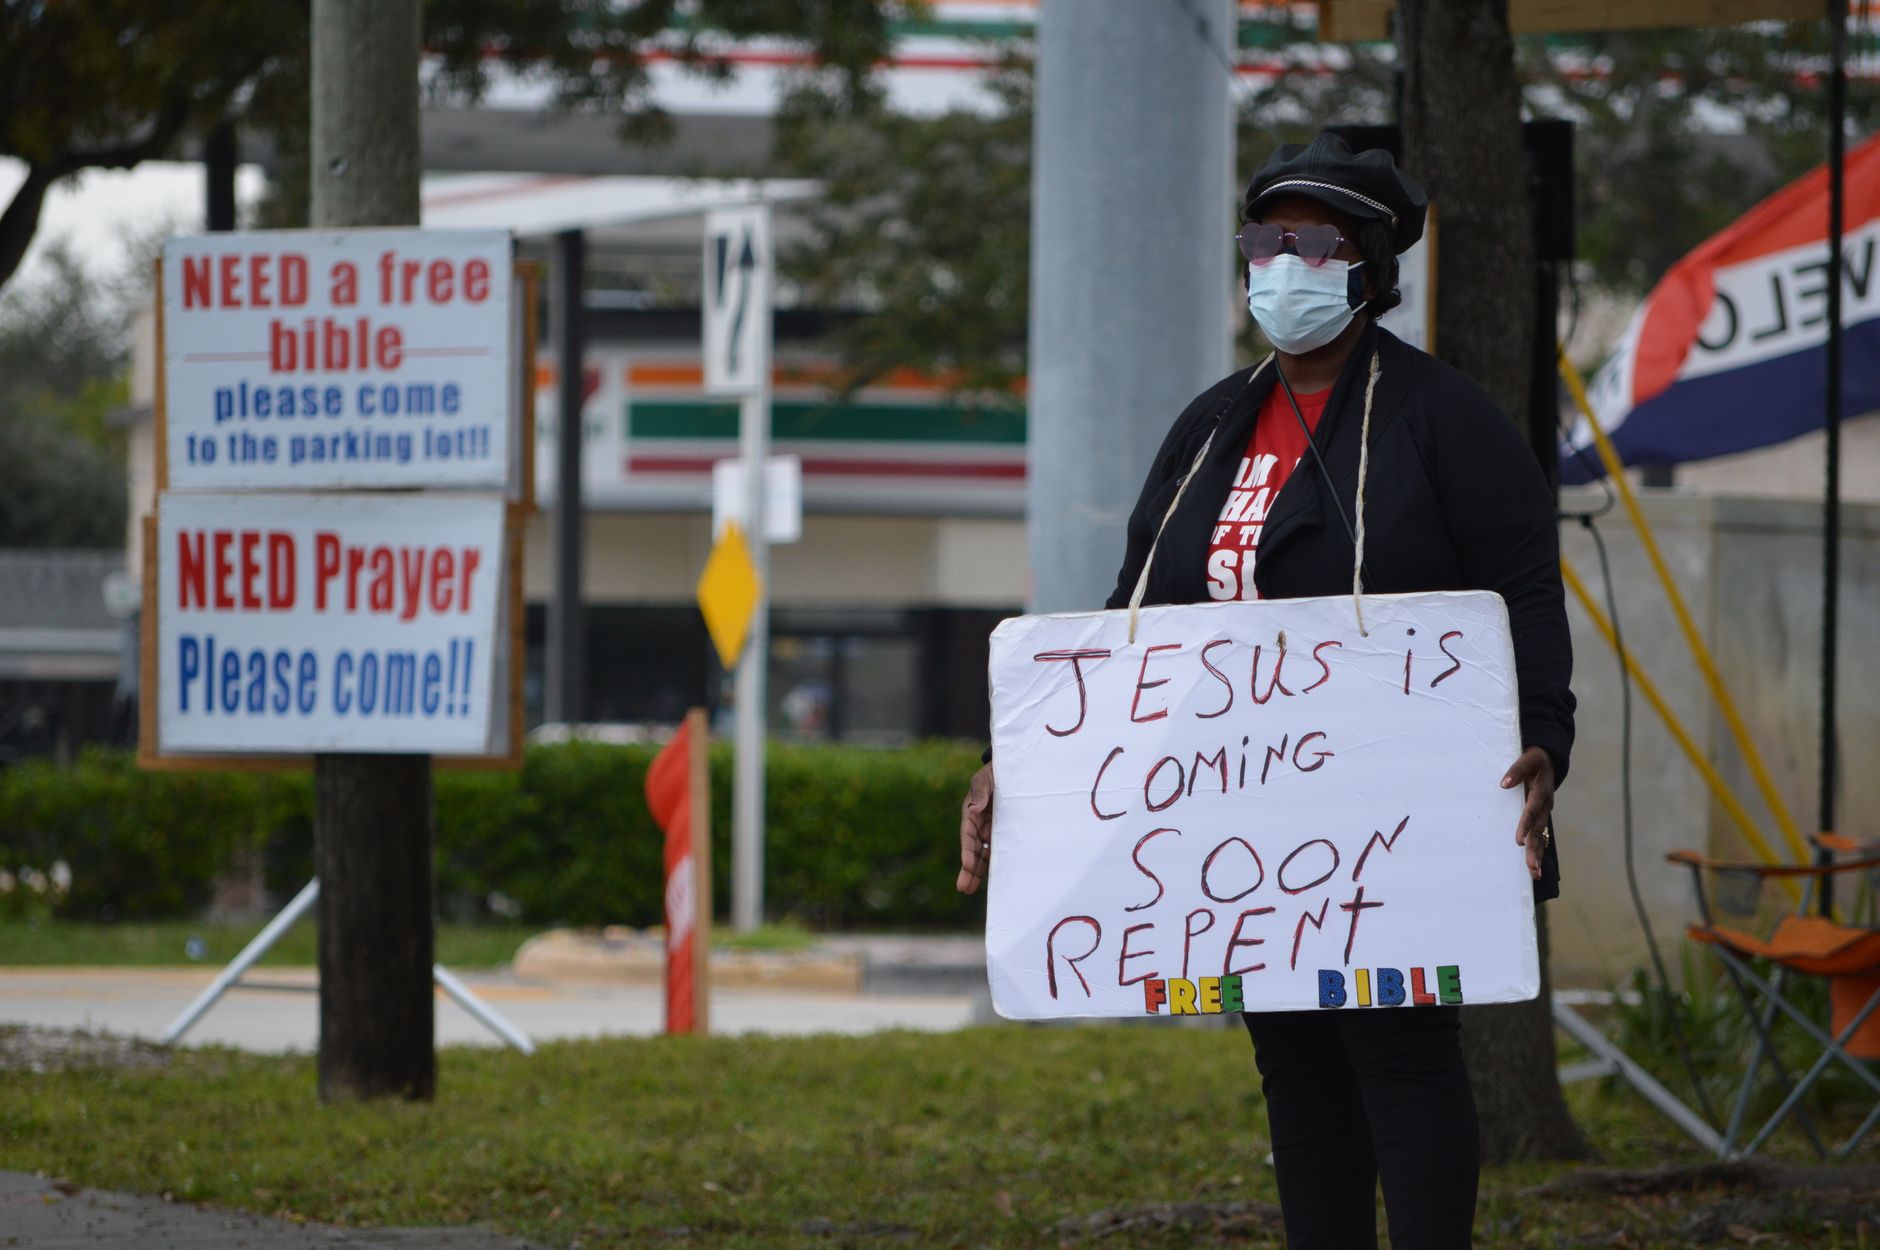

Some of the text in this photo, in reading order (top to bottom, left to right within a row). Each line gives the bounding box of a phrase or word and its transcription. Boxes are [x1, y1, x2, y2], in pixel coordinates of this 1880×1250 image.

[183, 250, 492, 310] NEED a free
[270, 317, 405, 373] bible
[213, 380, 461, 423] please come
[186, 424, 491, 465] to the parking lot!!
[178, 530, 481, 621] NEED Prayer
[178, 635, 475, 718] Please come!!
[1034, 639, 1342, 737] JESUS
[1124, 815, 1410, 912] SOON
[1144, 965, 1463, 1016] FREE BIBLE
